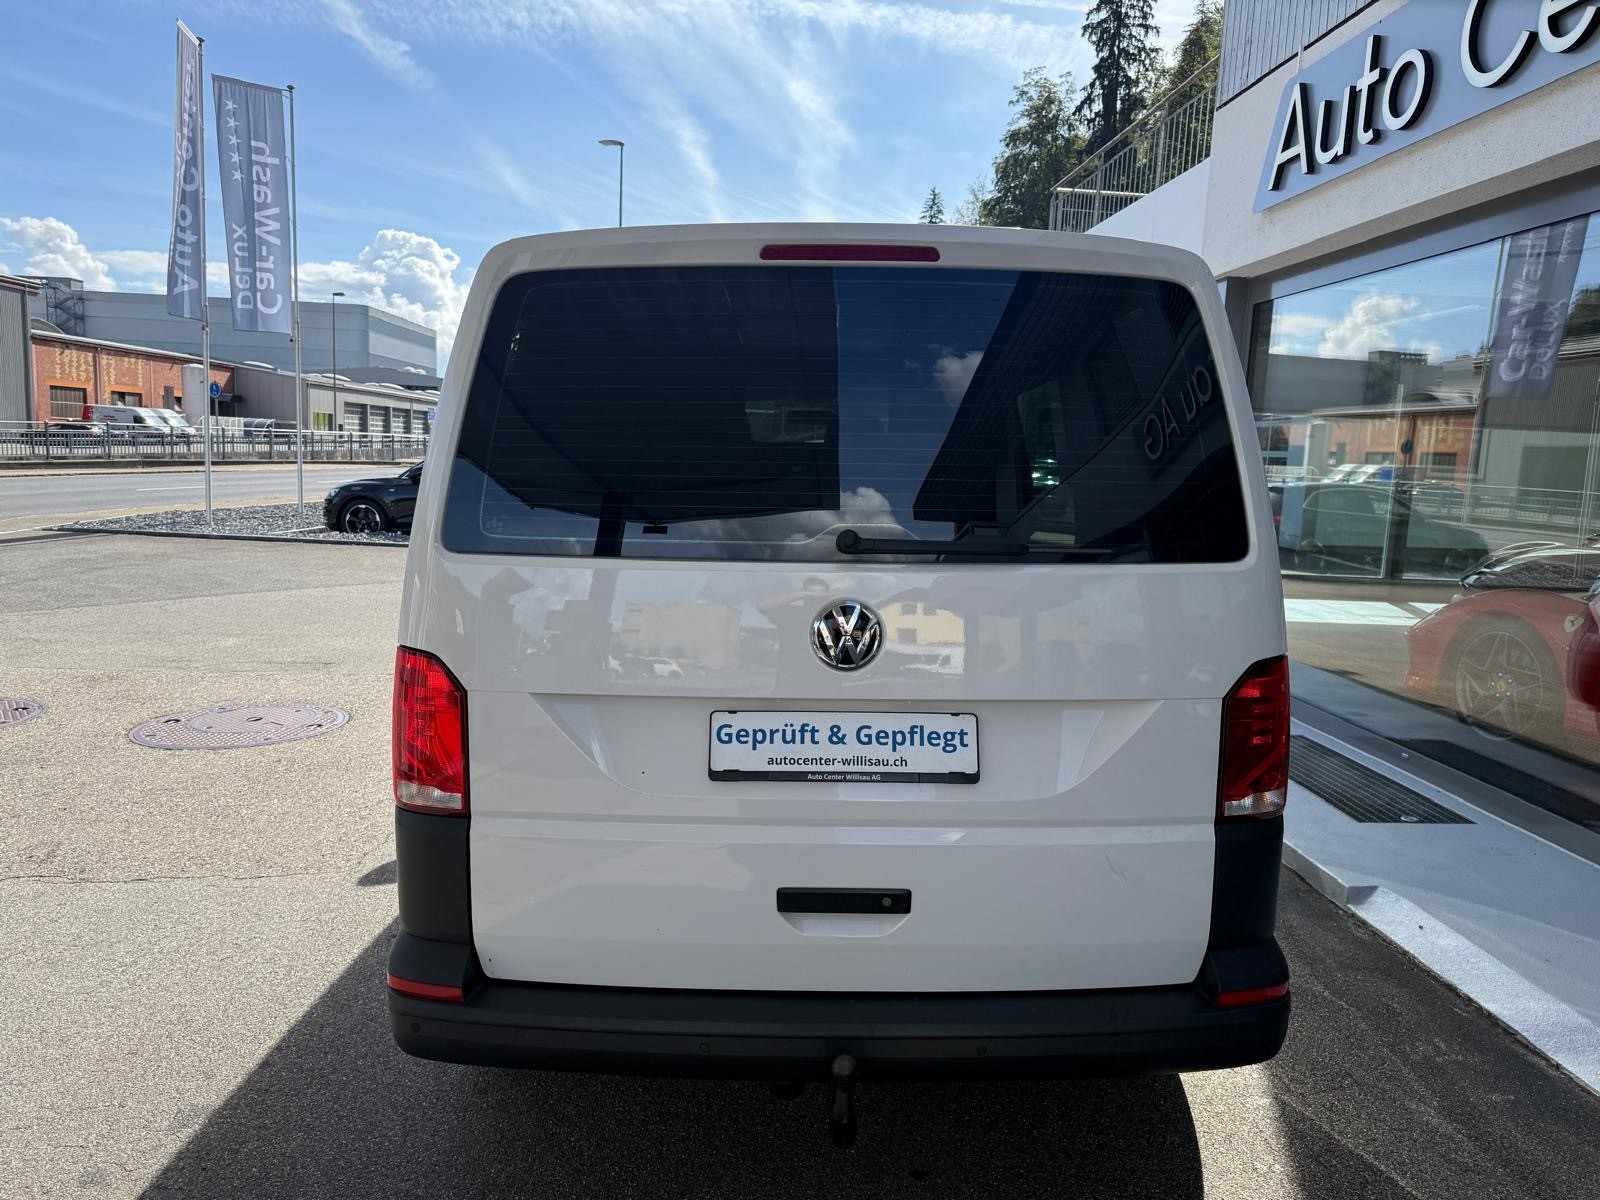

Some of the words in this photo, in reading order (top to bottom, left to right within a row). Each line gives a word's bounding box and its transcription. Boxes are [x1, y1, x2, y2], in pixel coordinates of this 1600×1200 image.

[1268, 34, 1434, 191] Auto
[1460, 0, 1600, 88] Ce
[715, 722, 820, 751] Geprüft
[827, 724, 848, 746] &
[855, 724, 969, 753] Gepflegt
[766, 754, 909, 768] autocenter-willisau.ch
[807, 773, 823, 781] Auto
[823, 773, 845, 781] Center
[845, 773, 871, 781] Willisau
